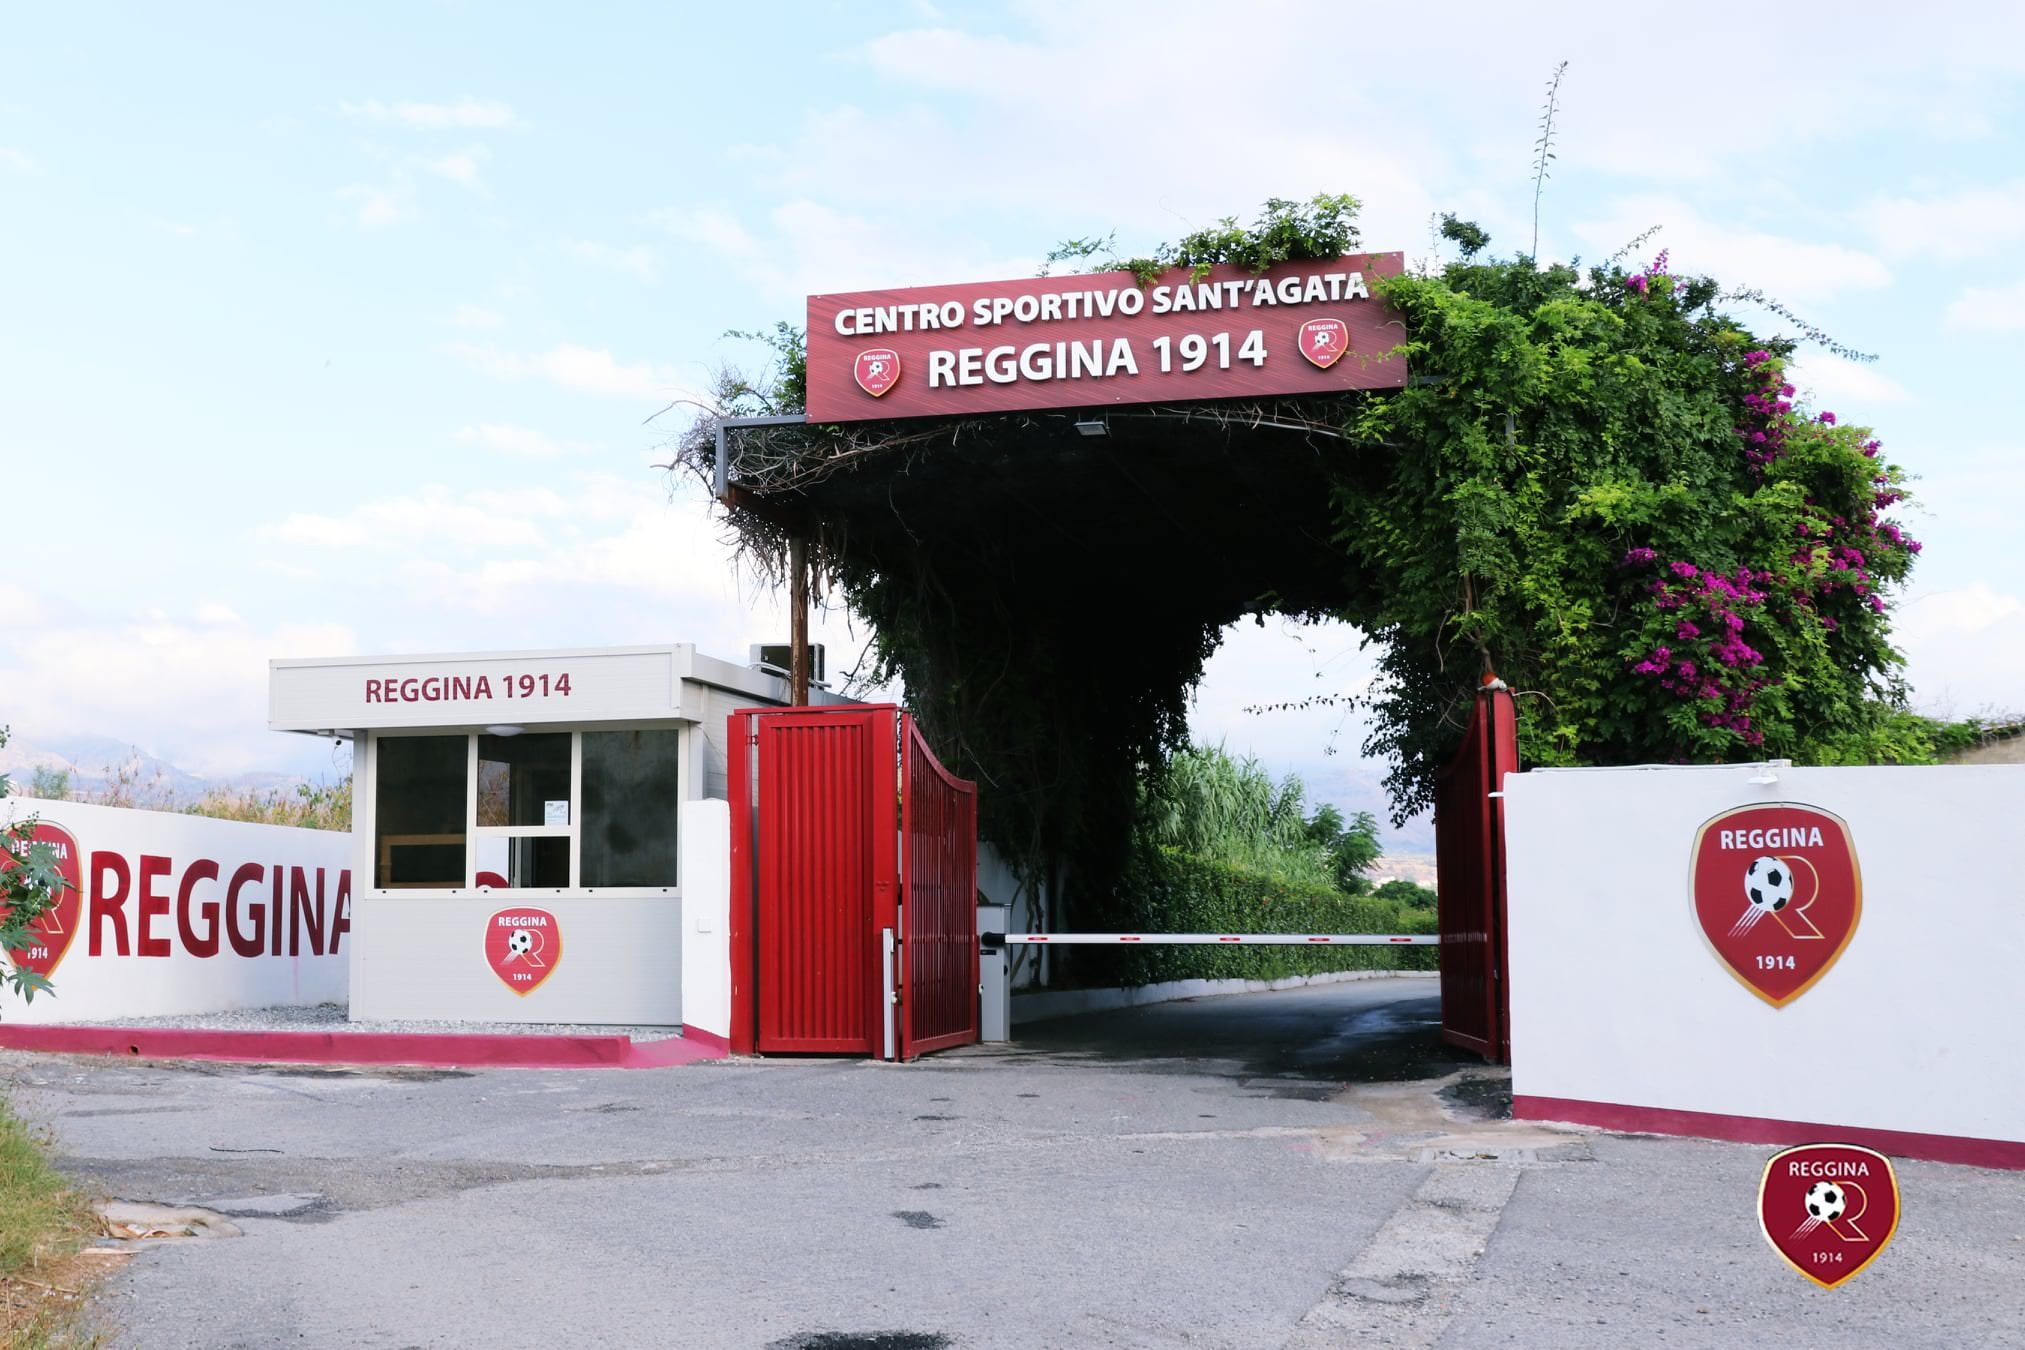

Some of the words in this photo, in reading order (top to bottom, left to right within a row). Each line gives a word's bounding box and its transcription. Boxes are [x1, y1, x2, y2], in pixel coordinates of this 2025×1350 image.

[833, 300, 966, 336] CENTRO
[972, 286, 1146, 326] SPORTIVO
[928, 337, 1140, 389] REGGINA
[1152, 329, 1269, 373] 1914
[365, 673, 493, 703] REGGINA
[501, 673, 572, 698] 1914
[1719, 827, 1824, 850] REGGINA
[498, 917, 547, 926] REGGINA
[1755, 955, 1796, 971] 1914
